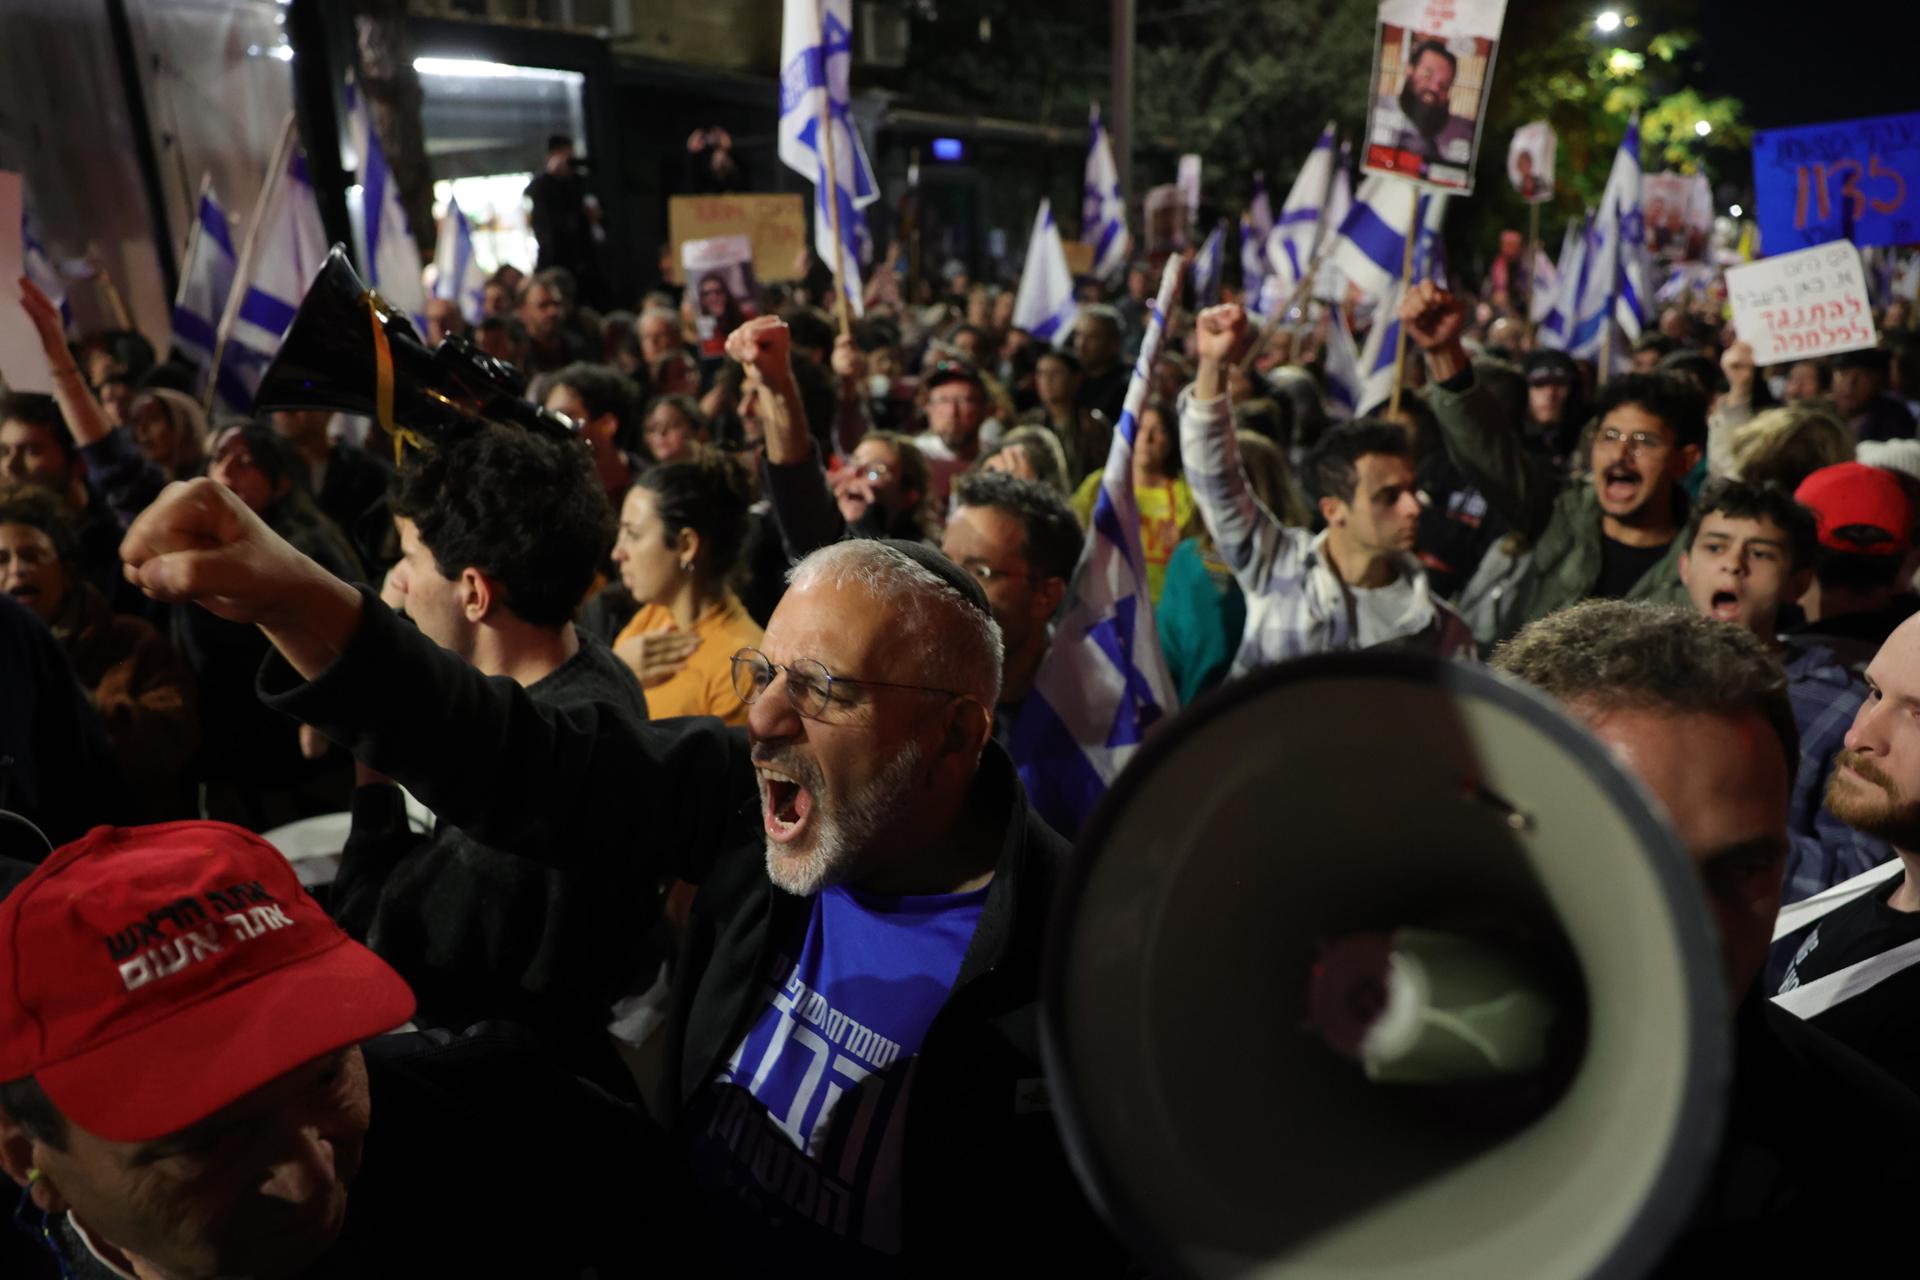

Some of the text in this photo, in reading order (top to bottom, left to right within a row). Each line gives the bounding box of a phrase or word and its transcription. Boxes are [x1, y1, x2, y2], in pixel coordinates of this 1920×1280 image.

[1760, 291, 1861, 332] להתנגד
[105, 880, 276, 960] אתה הראש
[224, 903, 295, 942] אתה
